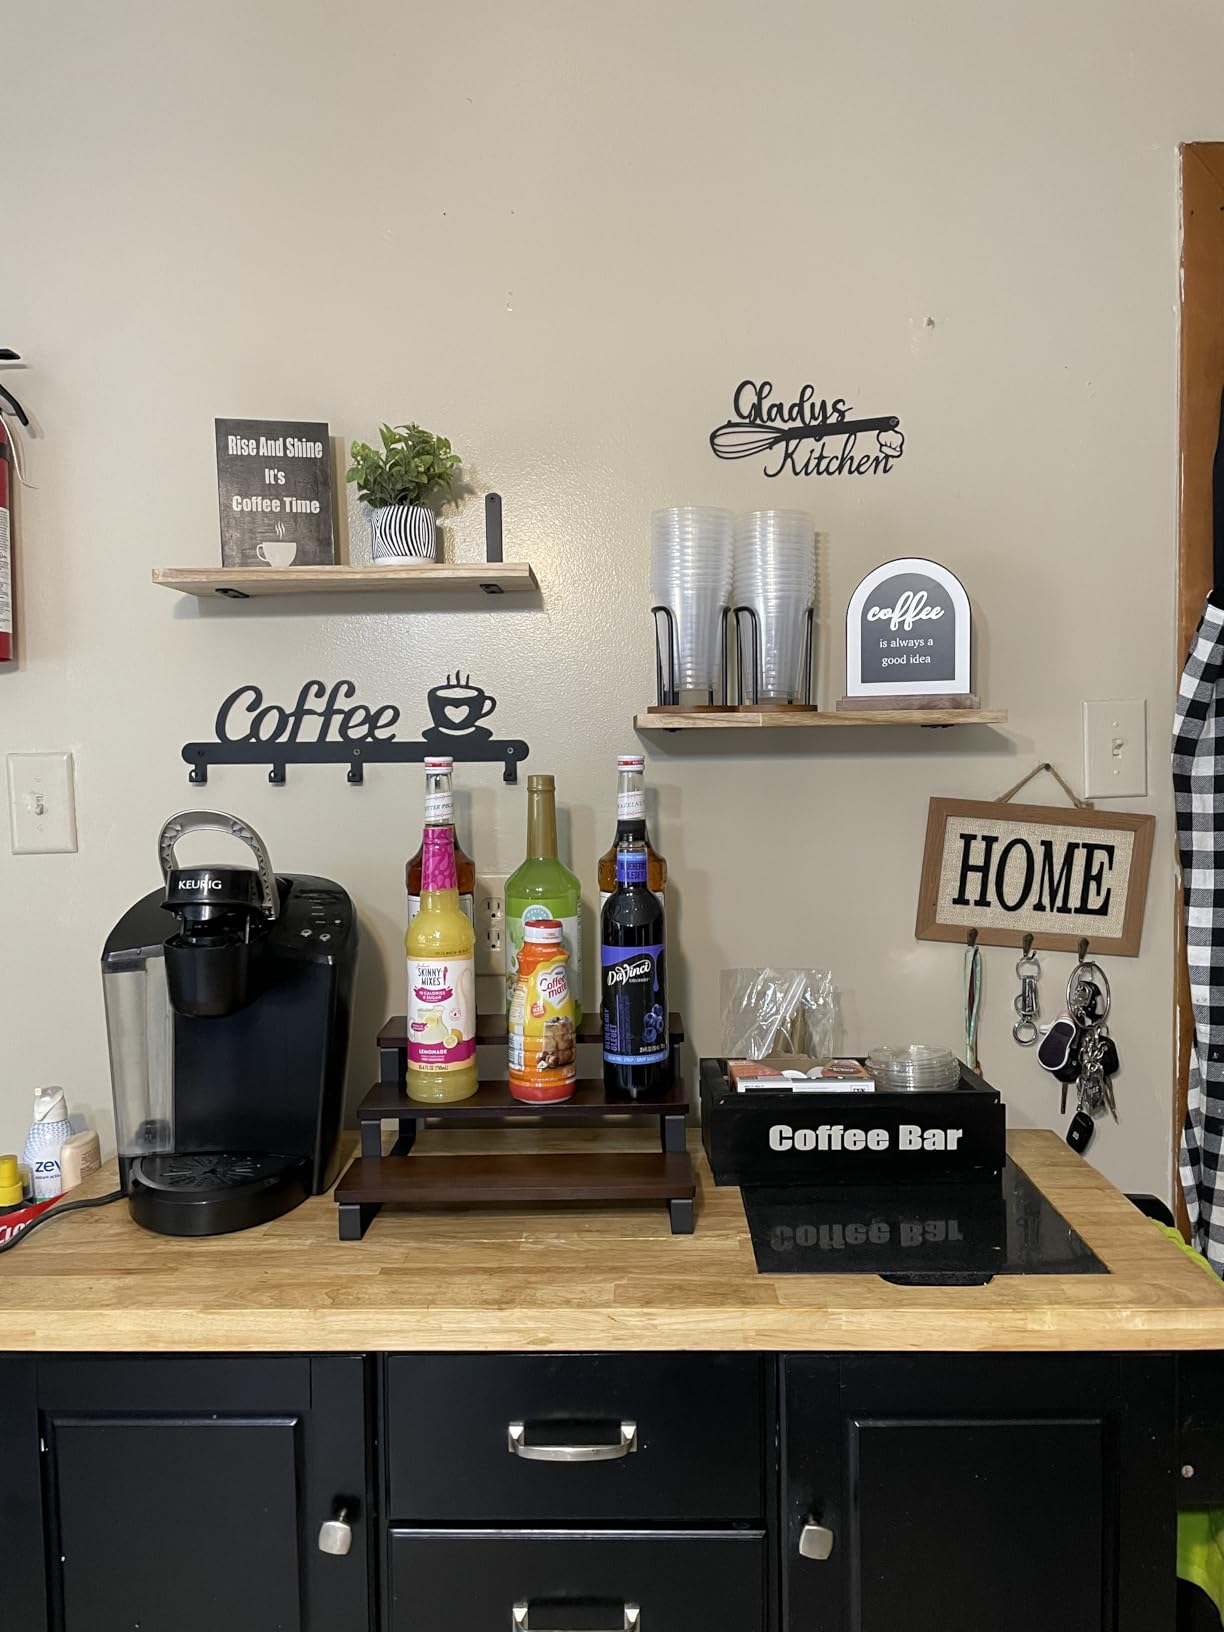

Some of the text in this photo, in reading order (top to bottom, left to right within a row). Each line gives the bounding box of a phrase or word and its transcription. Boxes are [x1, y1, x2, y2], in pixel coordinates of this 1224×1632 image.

[733, 380, 853, 440] Gladys
[228, 435, 323, 459] Rise And Shine
[764, 433, 893, 477] Kitchen
[265, 468, 286, 485] It's
[232, 495, 320, 514] Coffee Time
[867, 590, 945, 631] coffee
[879, 637, 934, 651] is always a
[881, 653, 931, 668] good idea
[215, 680, 400, 743] Coffee
[952, 833, 1115, 916] HOME
[178, 880, 222, 889] KEURIG
[417, 968, 441, 977] SKINNY
[421, 977, 441, 986] MIXES
[607, 959, 652, 986] DaVinci
[540, 975, 566, 992] Coffee
[548, 982, 568, 998] mate
[769, 1125, 963, 1151] Coffee Bar
